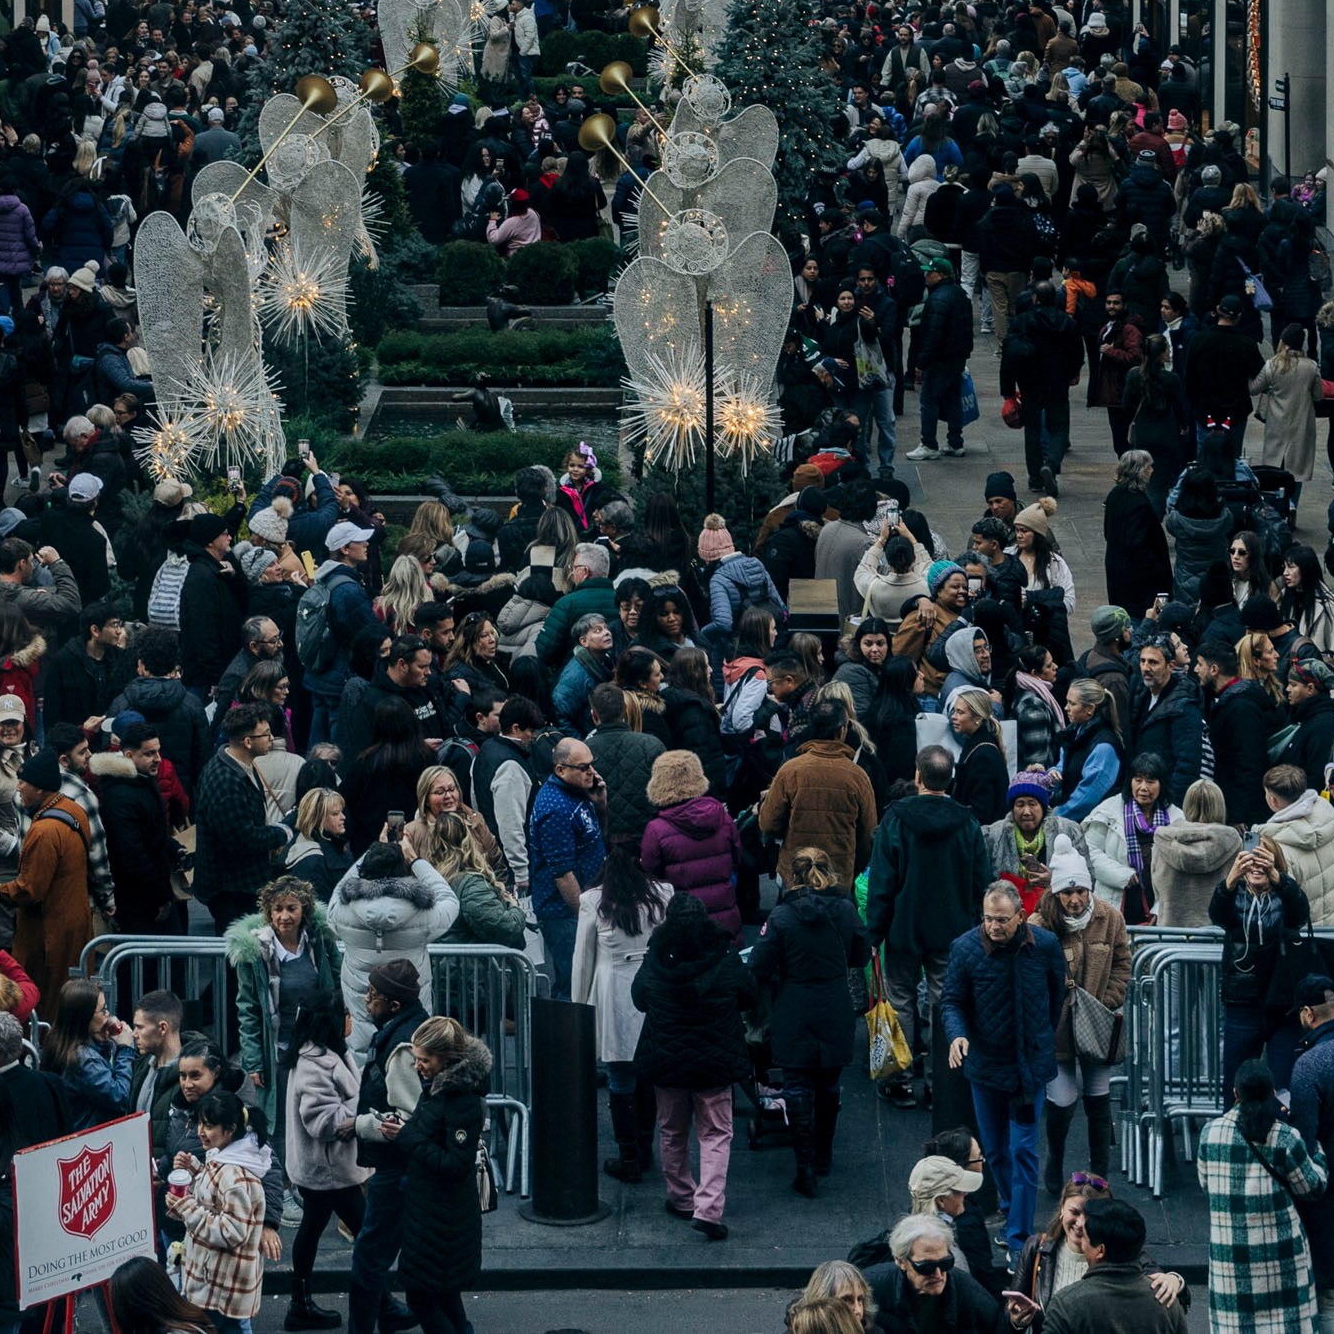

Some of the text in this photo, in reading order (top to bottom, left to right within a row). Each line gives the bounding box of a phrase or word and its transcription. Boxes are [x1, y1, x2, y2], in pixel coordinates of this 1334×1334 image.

[62, 1153, 110, 1224] SALVATION
[69, 1154, 91, 1191] THE
[81, 1180, 110, 1232] ARMY
[28, 1229, 148, 1279] DOING THE MOST GOOD
